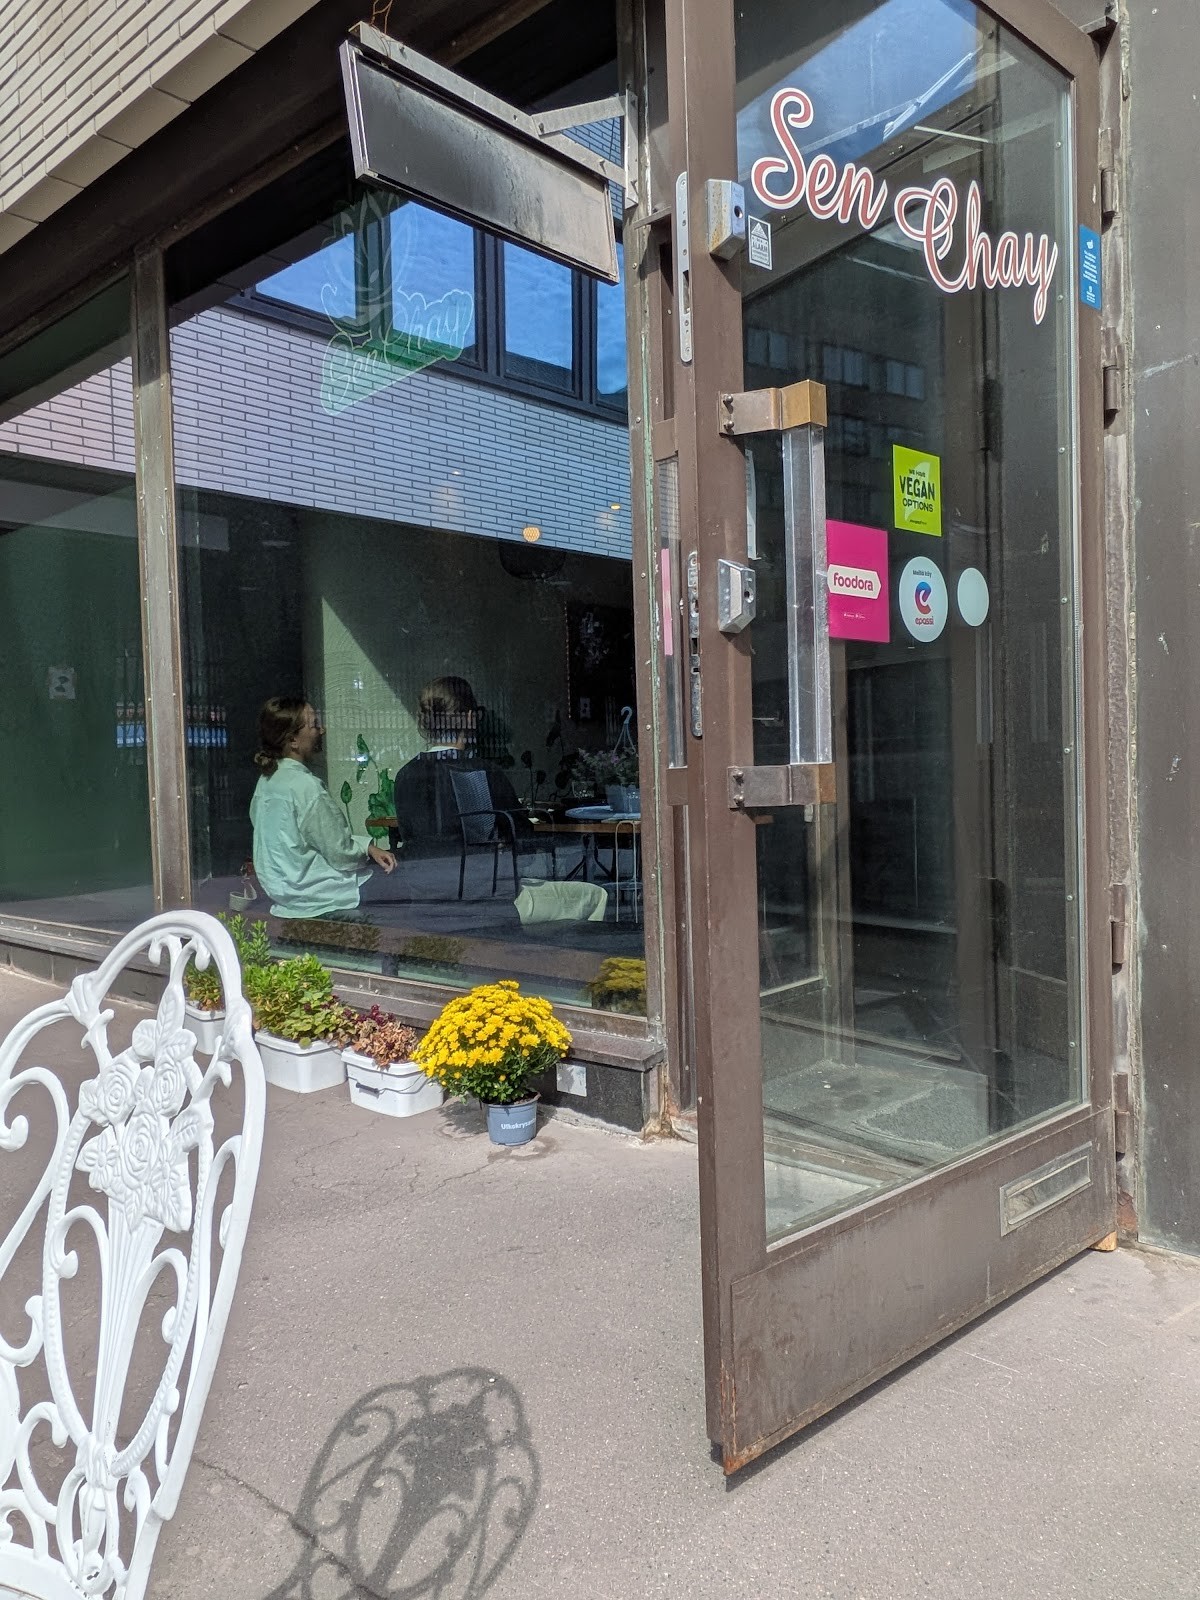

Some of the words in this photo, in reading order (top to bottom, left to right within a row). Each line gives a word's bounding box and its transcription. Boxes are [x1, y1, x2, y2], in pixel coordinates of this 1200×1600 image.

[751, 87, 888, 229] Sen
[894, 177, 1059, 325] Chay
[899, 475, 936, 502] VEGAN
[902, 498, 934, 513] OPTIONS
[833, 572, 874, 592] foodora
[915, 615, 935, 626] epassi
